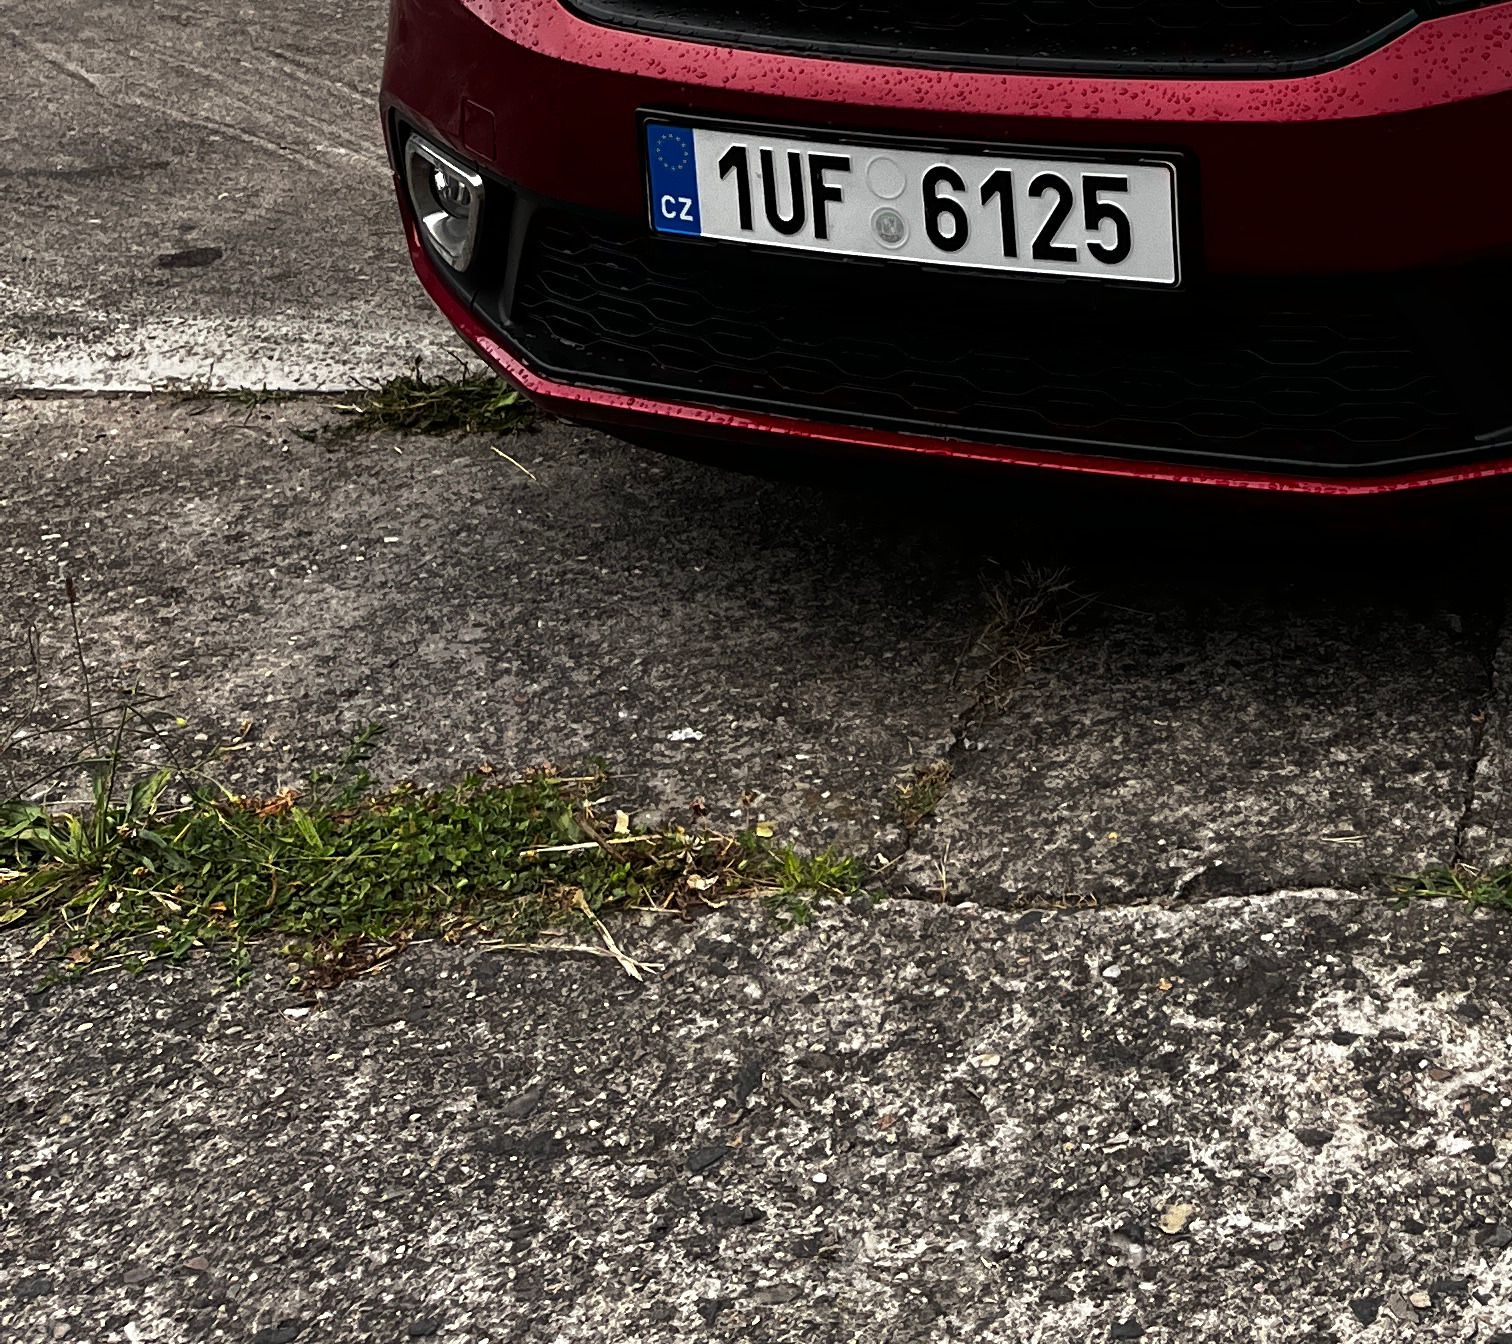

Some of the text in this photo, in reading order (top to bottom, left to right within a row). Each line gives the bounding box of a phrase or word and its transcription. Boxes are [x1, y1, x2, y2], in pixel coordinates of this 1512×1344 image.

[660, 194, 694, 222] CZ
[718, 145, 1132, 264] 1UF 6125
